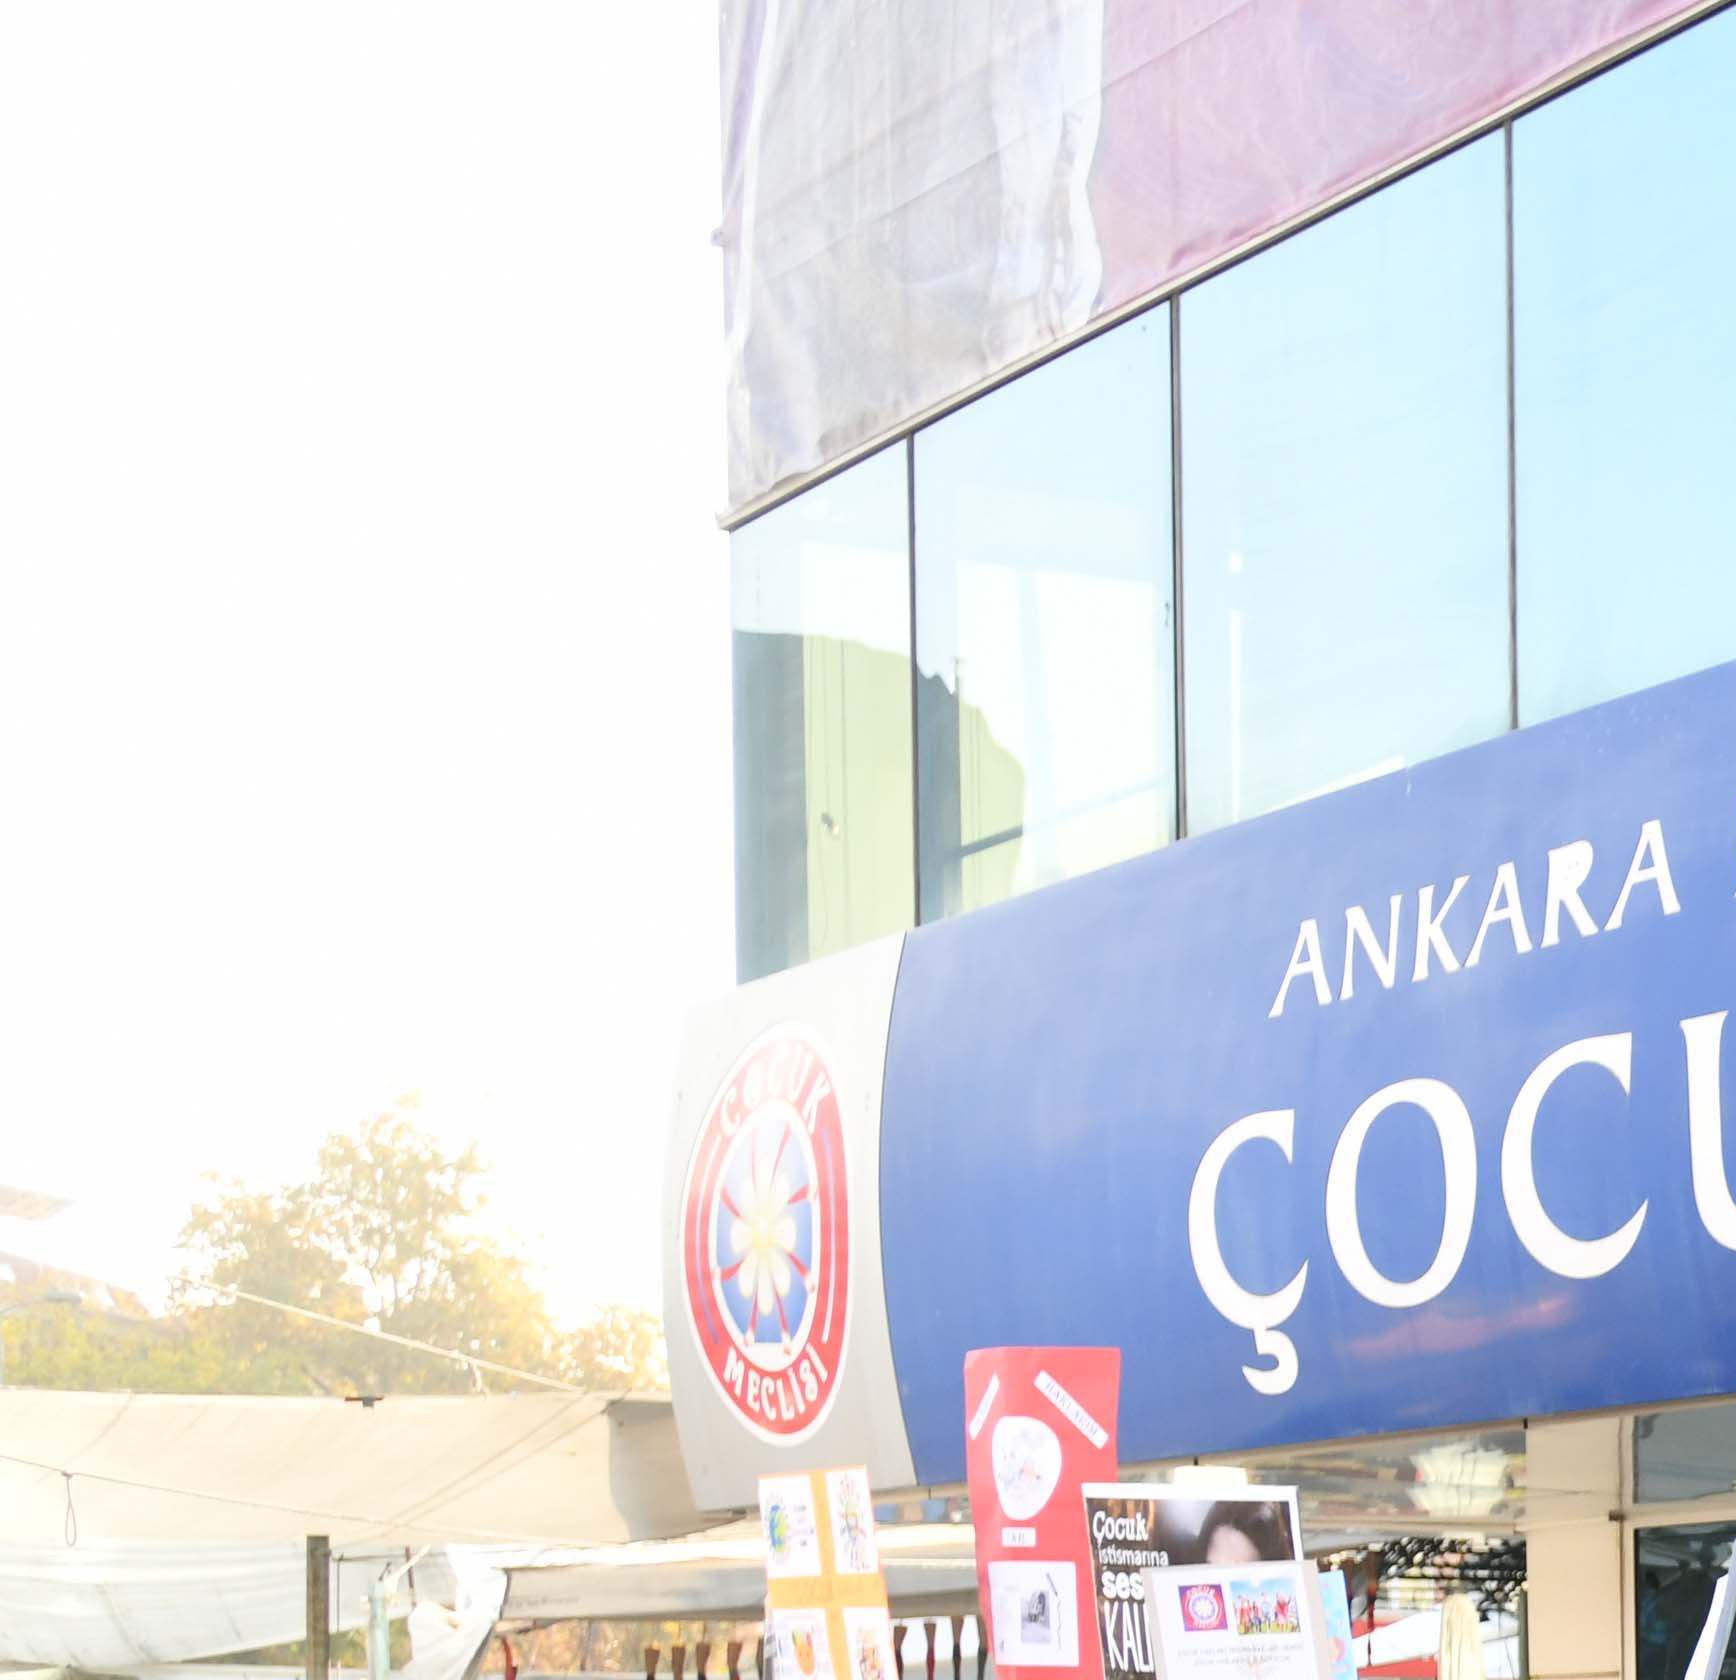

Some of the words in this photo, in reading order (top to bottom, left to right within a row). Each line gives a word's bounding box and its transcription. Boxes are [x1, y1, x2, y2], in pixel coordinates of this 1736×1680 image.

[1266, 819, 1682, 1019] ANKARA
[722, 1341, 831, 1422] MECLİSİ
[1093, 1511, 1148, 1545] Çocuk
[1104, 1600, 1156, 1673] KAL
